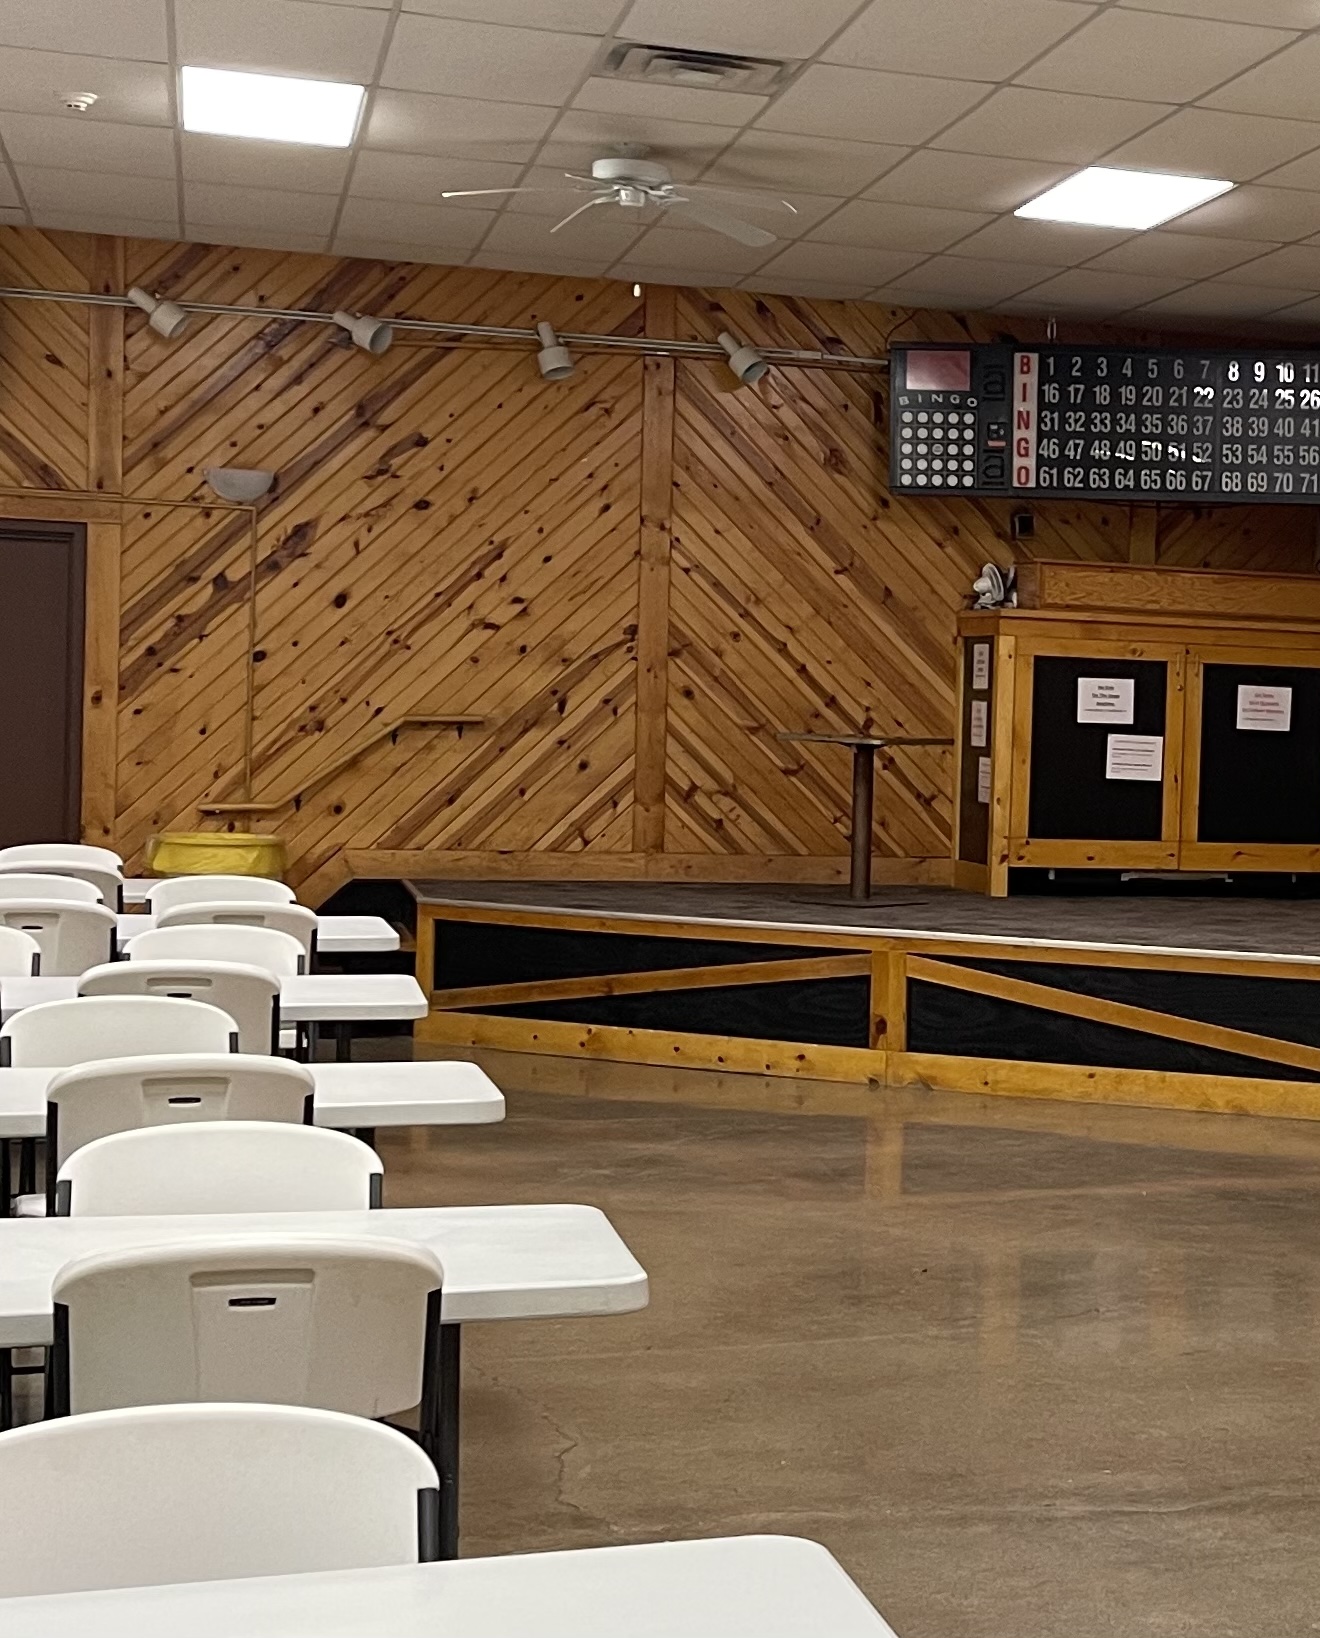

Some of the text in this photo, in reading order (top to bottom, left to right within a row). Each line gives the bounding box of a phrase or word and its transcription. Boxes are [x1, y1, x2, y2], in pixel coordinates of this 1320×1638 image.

[1046, 356, 1055, 377] 1
[1071, 356, 1082, 377] 2
[1096, 356, 1108, 377] 3
[1121, 357, 1133, 378] 4
[1147, 358, 1158, 379] 5
[1173, 358, 1184, 380] 6
[1199, 359, 1211, 380] 7
[1227, 360, 1240, 382] 8
[1253, 361, 1266, 383] 9
[1275, 362, 1295, 383] 10
[1302, 363, 1319, 384] 11
[1041, 382, 1060, 404] 16
[1067, 383, 1085, 404] 17
[1092, 384, 1111, 405] 18
[1118, 384, 1136, 406] 19
[1142, 385, 1163, 407] 20
[1168, 385, 1188, 407] 21
[1193, 386, 1215, 408] 22
[1222, 388, 1244, 409] 23
[1249, 388, 1269, 410] 24
[1274, 388, 1295, 410] 25
[1040, 410, 1059, 432] 31
[1064, 411, 1086, 432] 32
[1090, 411, 1111, 433] 33
[1115, 412, 1136, 433] 34
[1141, 413, 1162, 434] 35
[1167, 414, 1188, 435] 36
[1192, 415, 1214, 436] 37
[1222, 416, 1243, 437] 38
[1247, 416, 1269, 438] 39
[1273, 417, 1295, 438] 40
[1300, 417, 1320, 438] 41
[1038, 438, 1060, 459] 46
[1064, 439, 1085, 460] 47
[1089, 439, 1112, 461] 48
[1114, 440, 1136, 461] 49
[1141, 440, 1163, 461] 50
[1167, 441, 1186, 462] 51
[1191, 442, 1213, 464] 52
[1222, 443, 1243, 465] 53
[1247, 444, 1268, 465] 54
[1273, 445, 1294, 466] 55
[1298, 445, 1320, 466] 56
[1039, 466, 1058, 487] 61
[1063, 467, 1084, 488] 62
[1089, 467, 1110, 489] 63
[1114, 468, 1135, 489] 64
[1140, 469, 1161, 490] 65
[1165, 468, 1187, 491] 66
[1191, 470, 1213, 491] 67
[1221, 471, 1242, 492] 68
[1247, 472, 1268, 493] 69
[1273, 472, 1293, 493] 70
[1299, 472, 1318, 494] 71
